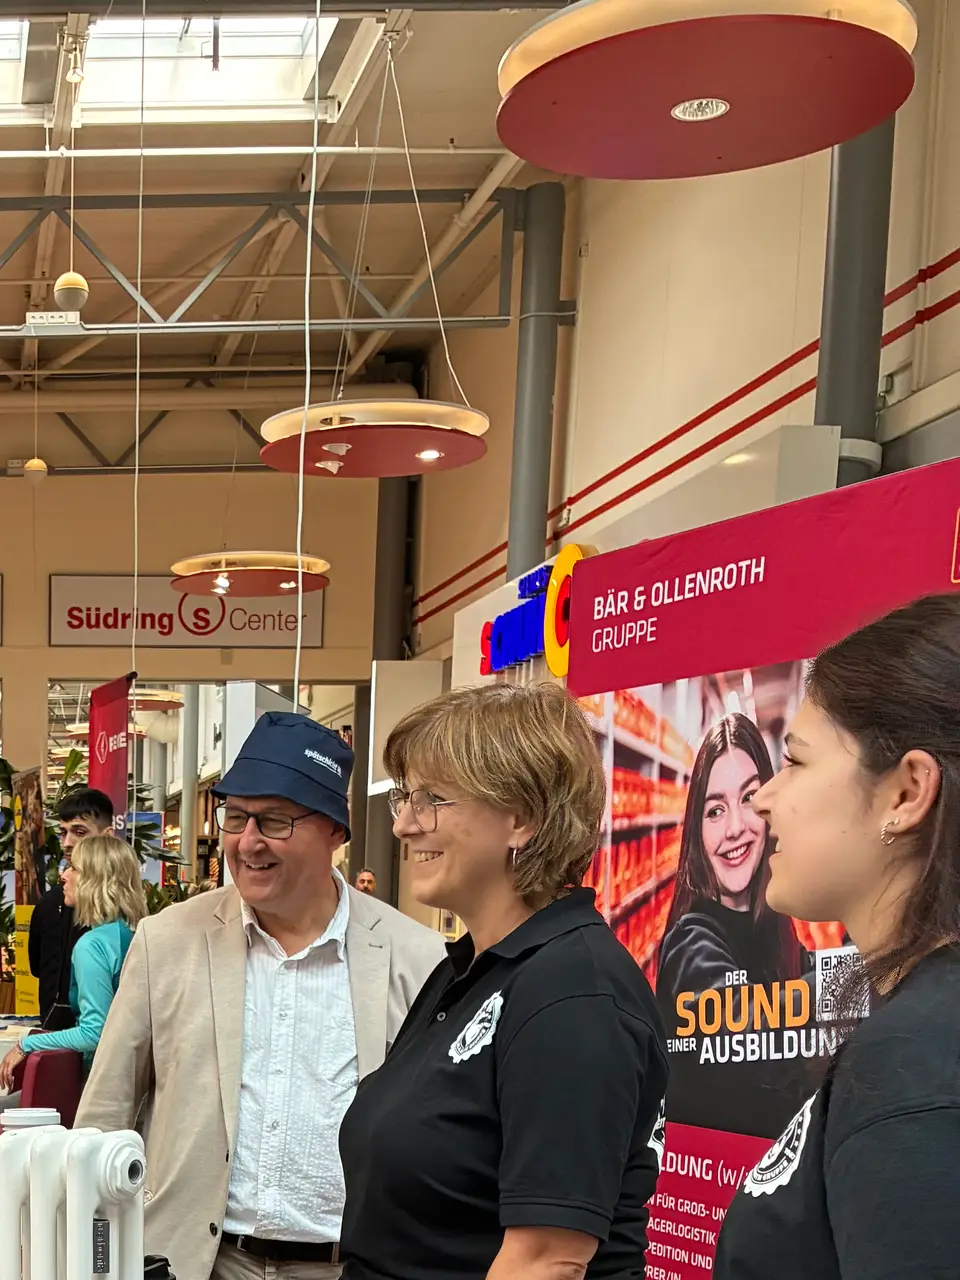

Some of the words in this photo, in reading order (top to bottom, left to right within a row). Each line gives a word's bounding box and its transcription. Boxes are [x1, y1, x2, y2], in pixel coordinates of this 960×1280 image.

[594, 588, 628, 620] BÄR
[633, 586, 646, 611] &
[651, 556, 765, 607] OLLENROTH
[66, 606, 174, 636] Südring
[229, 607, 307, 631] Center
[592, 617, 658, 653] GRUPPE
[725, 970, 748, 986] DER
[676, 979, 810, 1037] SOUND
[656, 1193, 675, 1209] FÜR
[691, 1253, 713, 1270] UND
